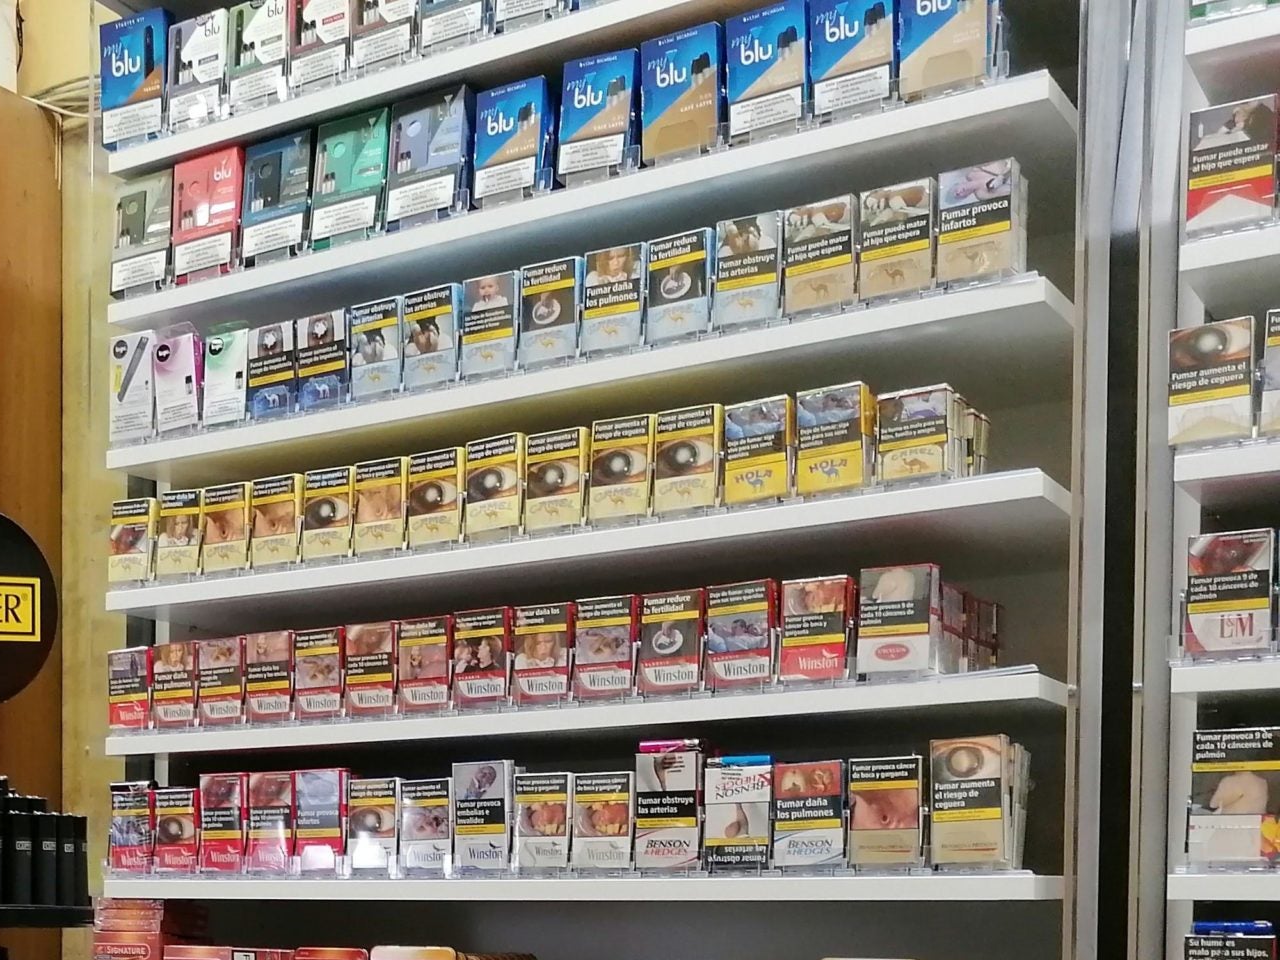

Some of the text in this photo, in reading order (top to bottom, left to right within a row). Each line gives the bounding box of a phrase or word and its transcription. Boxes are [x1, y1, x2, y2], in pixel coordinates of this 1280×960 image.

[267, 2, 285, 19] blu
[825, 15, 858, 43] blu
[740, 37, 773, 66] blu
[112, 51, 141, 77] blu
[656, 61, 687, 89] blu
[574, 83, 602, 108] blu
[486, 117, 514, 137] blu
[1193, 142, 1268, 165] Fumar puede matar
[214, 166, 232, 180] blu
[941, 199, 1009, 221] Fumar provoca
[788, 234, 848, 254] Fumar puede matar
[719, 253, 775, 271] Fumar obstruye
[586, 280, 633, 298] Fumar daña
[1172, 363, 1245, 382] Fumar aumenta el
[1172, 373, 1244, 391] riesgo de ceguera
[809, 459, 848, 474] HOLA
[1220, 613, 1253, 639] L&M
[799, 656, 838, 671] Winston
[588, 673, 626, 688] Winston
[654, 668, 693, 683] Winston
[466, 682, 501, 694] Winston
[527, 679, 563, 691] Winston
[357, 693, 389, 703] Winston
[411, 690, 444, 702] Winston
[163, 707, 190, 718] Winston
[1196, 731, 1272, 743] Fumar provoca 9 de
[1196, 749, 1225, 760] pulmón
[457, 800, 501, 811] Fumar provoca
[638, 796, 694, 805] Fumar obstruye
[777, 798, 828, 808] Fumar daña
[647, 840, 690, 848] BENSON
[789, 839, 832, 848] BENSON
[211, 851, 239, 862] Winston
[468, 847, 502, 860] Winston
[107, 946, 145, 954] SIGNATURE
